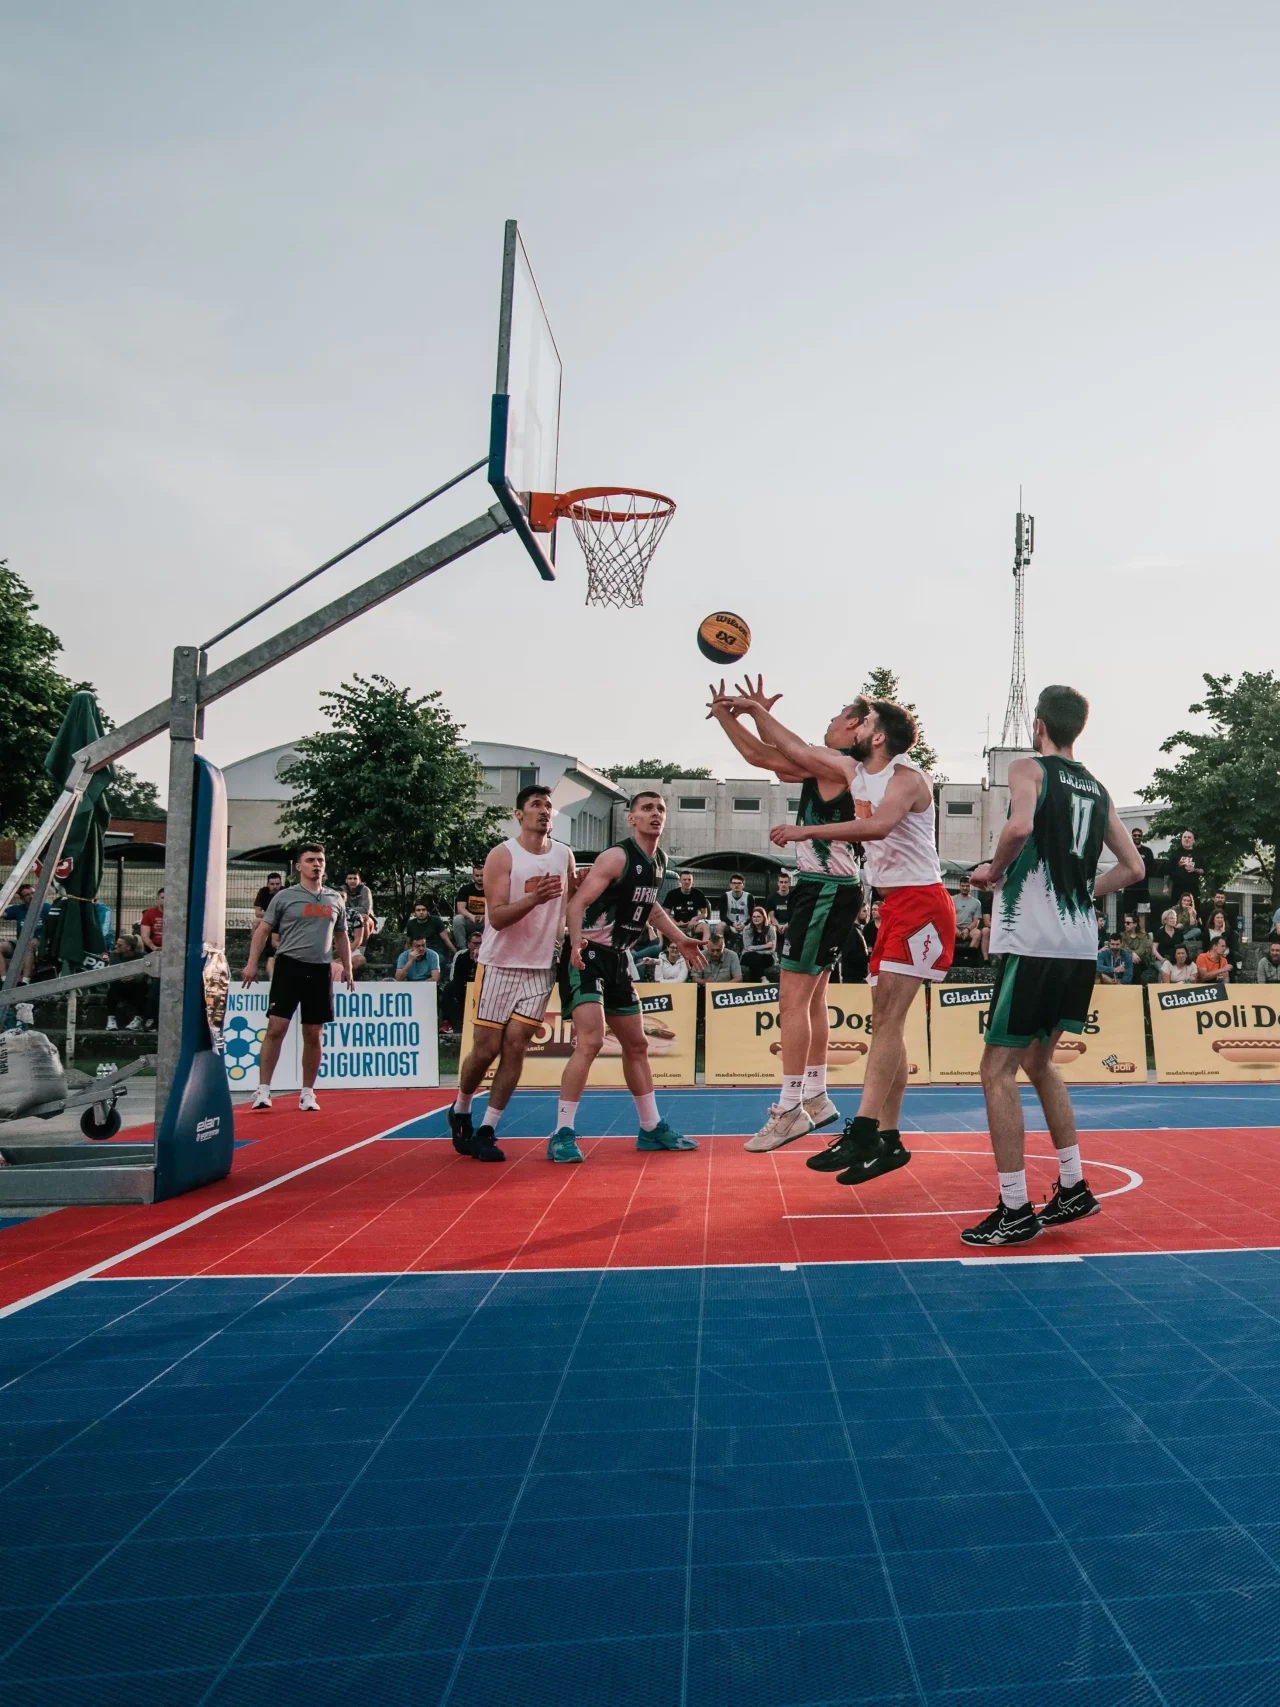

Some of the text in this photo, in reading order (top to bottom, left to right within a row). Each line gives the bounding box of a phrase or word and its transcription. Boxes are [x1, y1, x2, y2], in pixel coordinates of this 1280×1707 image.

[227, 994, 268, 1011] NSTITU
[333, 992, 413, 1018] NANJEM
[715, 988, 779, 1006] Gladni?
[942, 988, 994, 1004] Gladni
[1161, 988, 1219, 1008] Gladni?
[1196, 1005, 1247, 1034] poli
[531, 1015, 572, 1044] oli
[317, 1051, 420, 1078] SIGURNOST
[1113, 1062, 1131, 1073] poli
[196, 1116, 220, 1133] elan
